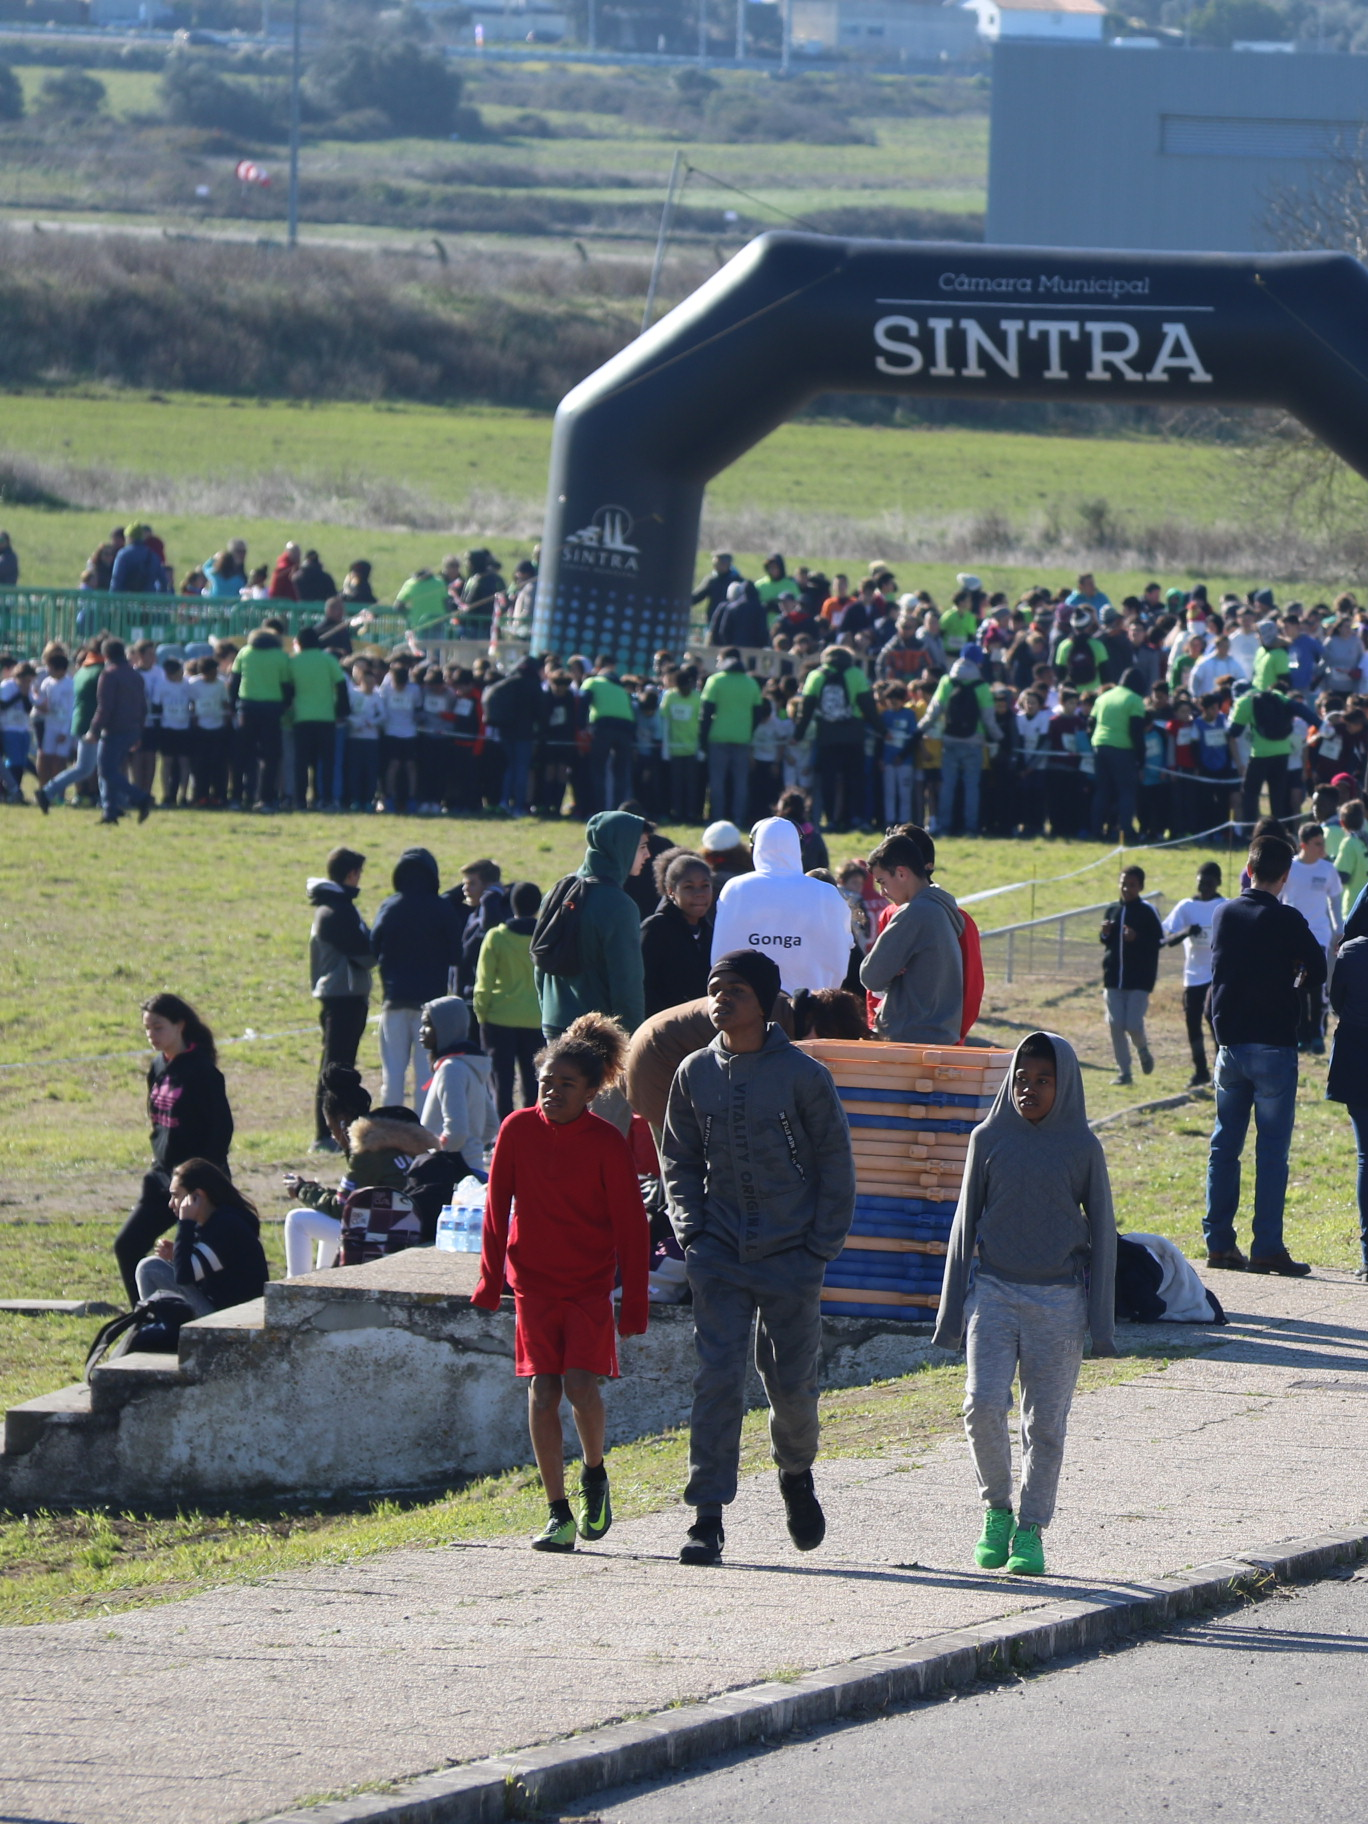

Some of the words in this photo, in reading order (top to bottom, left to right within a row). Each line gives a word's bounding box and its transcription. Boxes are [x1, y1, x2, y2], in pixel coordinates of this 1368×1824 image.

[938, 272, 1032, 293] Câmara
[1037, 275, 1150, 299] Municipal
[873, 315, 1213, 383] SINTRA
[562, 546, 639, 572] SINTRA
[748, 933, 802, 949] Gonga
[732, 1082, 749, 1162] VITALITY
[740, 1171, 759, 1252] ORIGINAL
